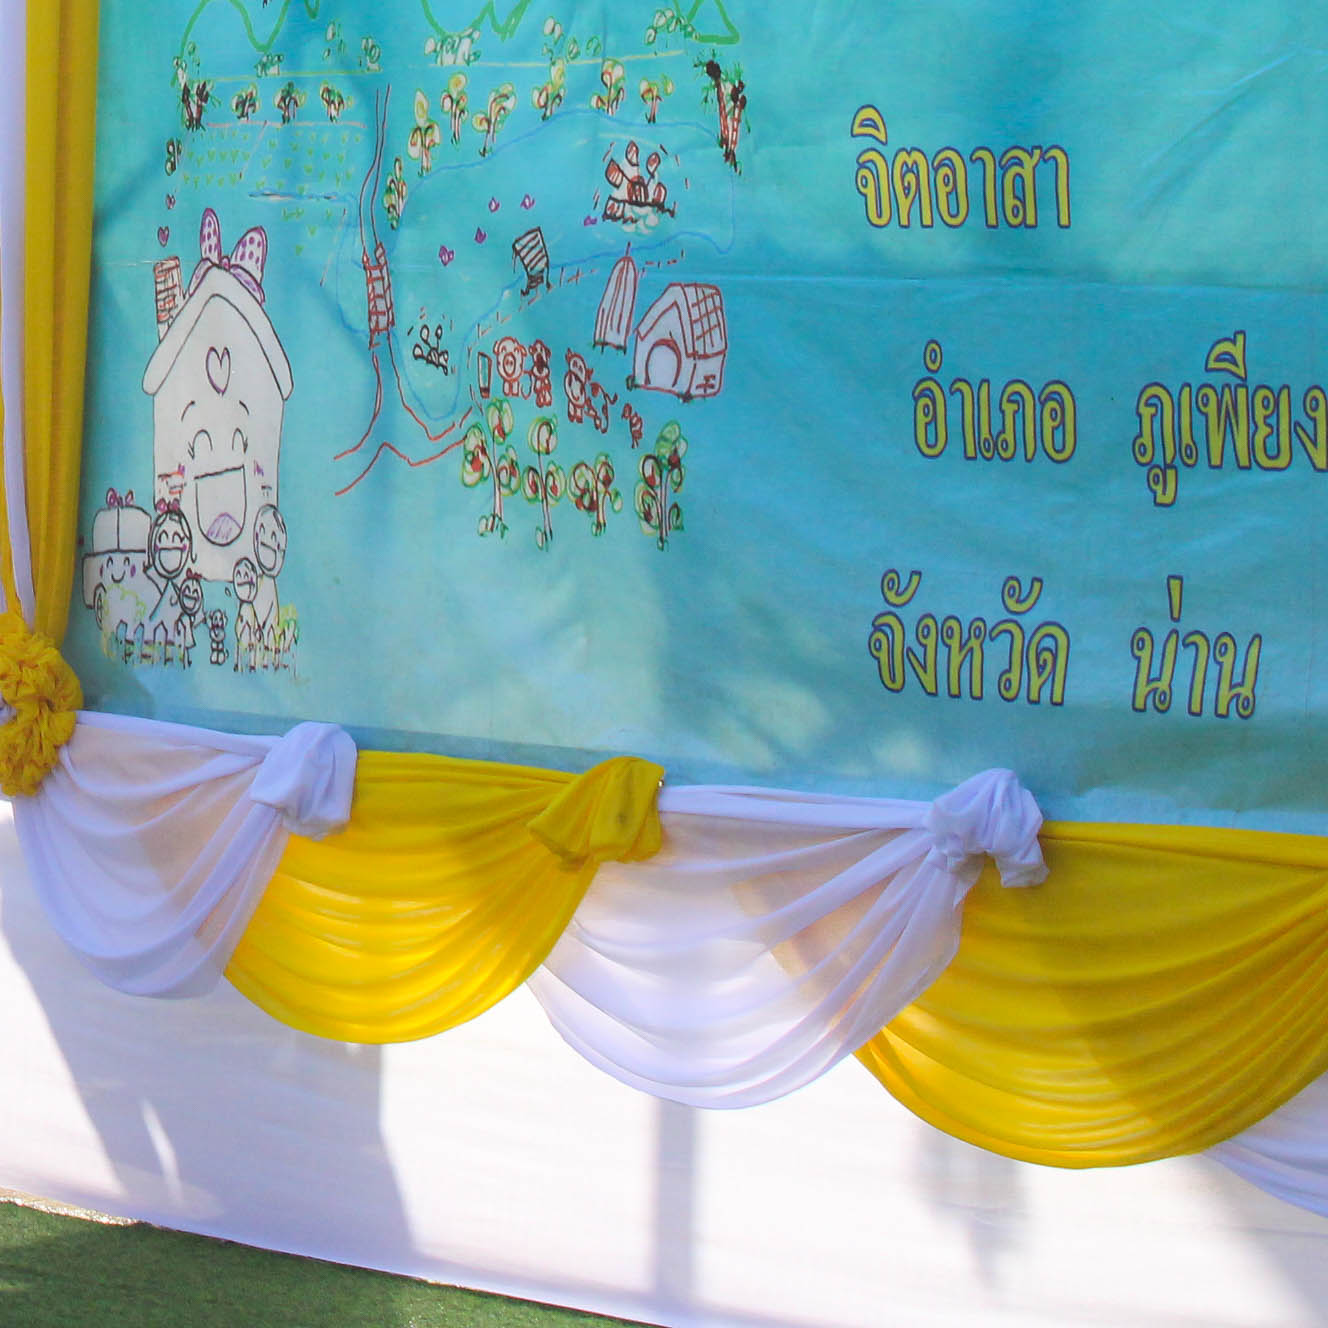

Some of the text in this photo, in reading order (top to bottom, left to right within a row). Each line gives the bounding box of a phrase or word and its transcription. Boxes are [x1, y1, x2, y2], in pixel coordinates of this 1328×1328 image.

[850, 105, 1072, 229] จิตอาสา
[912, 330, 1328, 506] อำเภอ ภูเพียง
[867, 568, 1262, 720] จังหวัด น่าน
